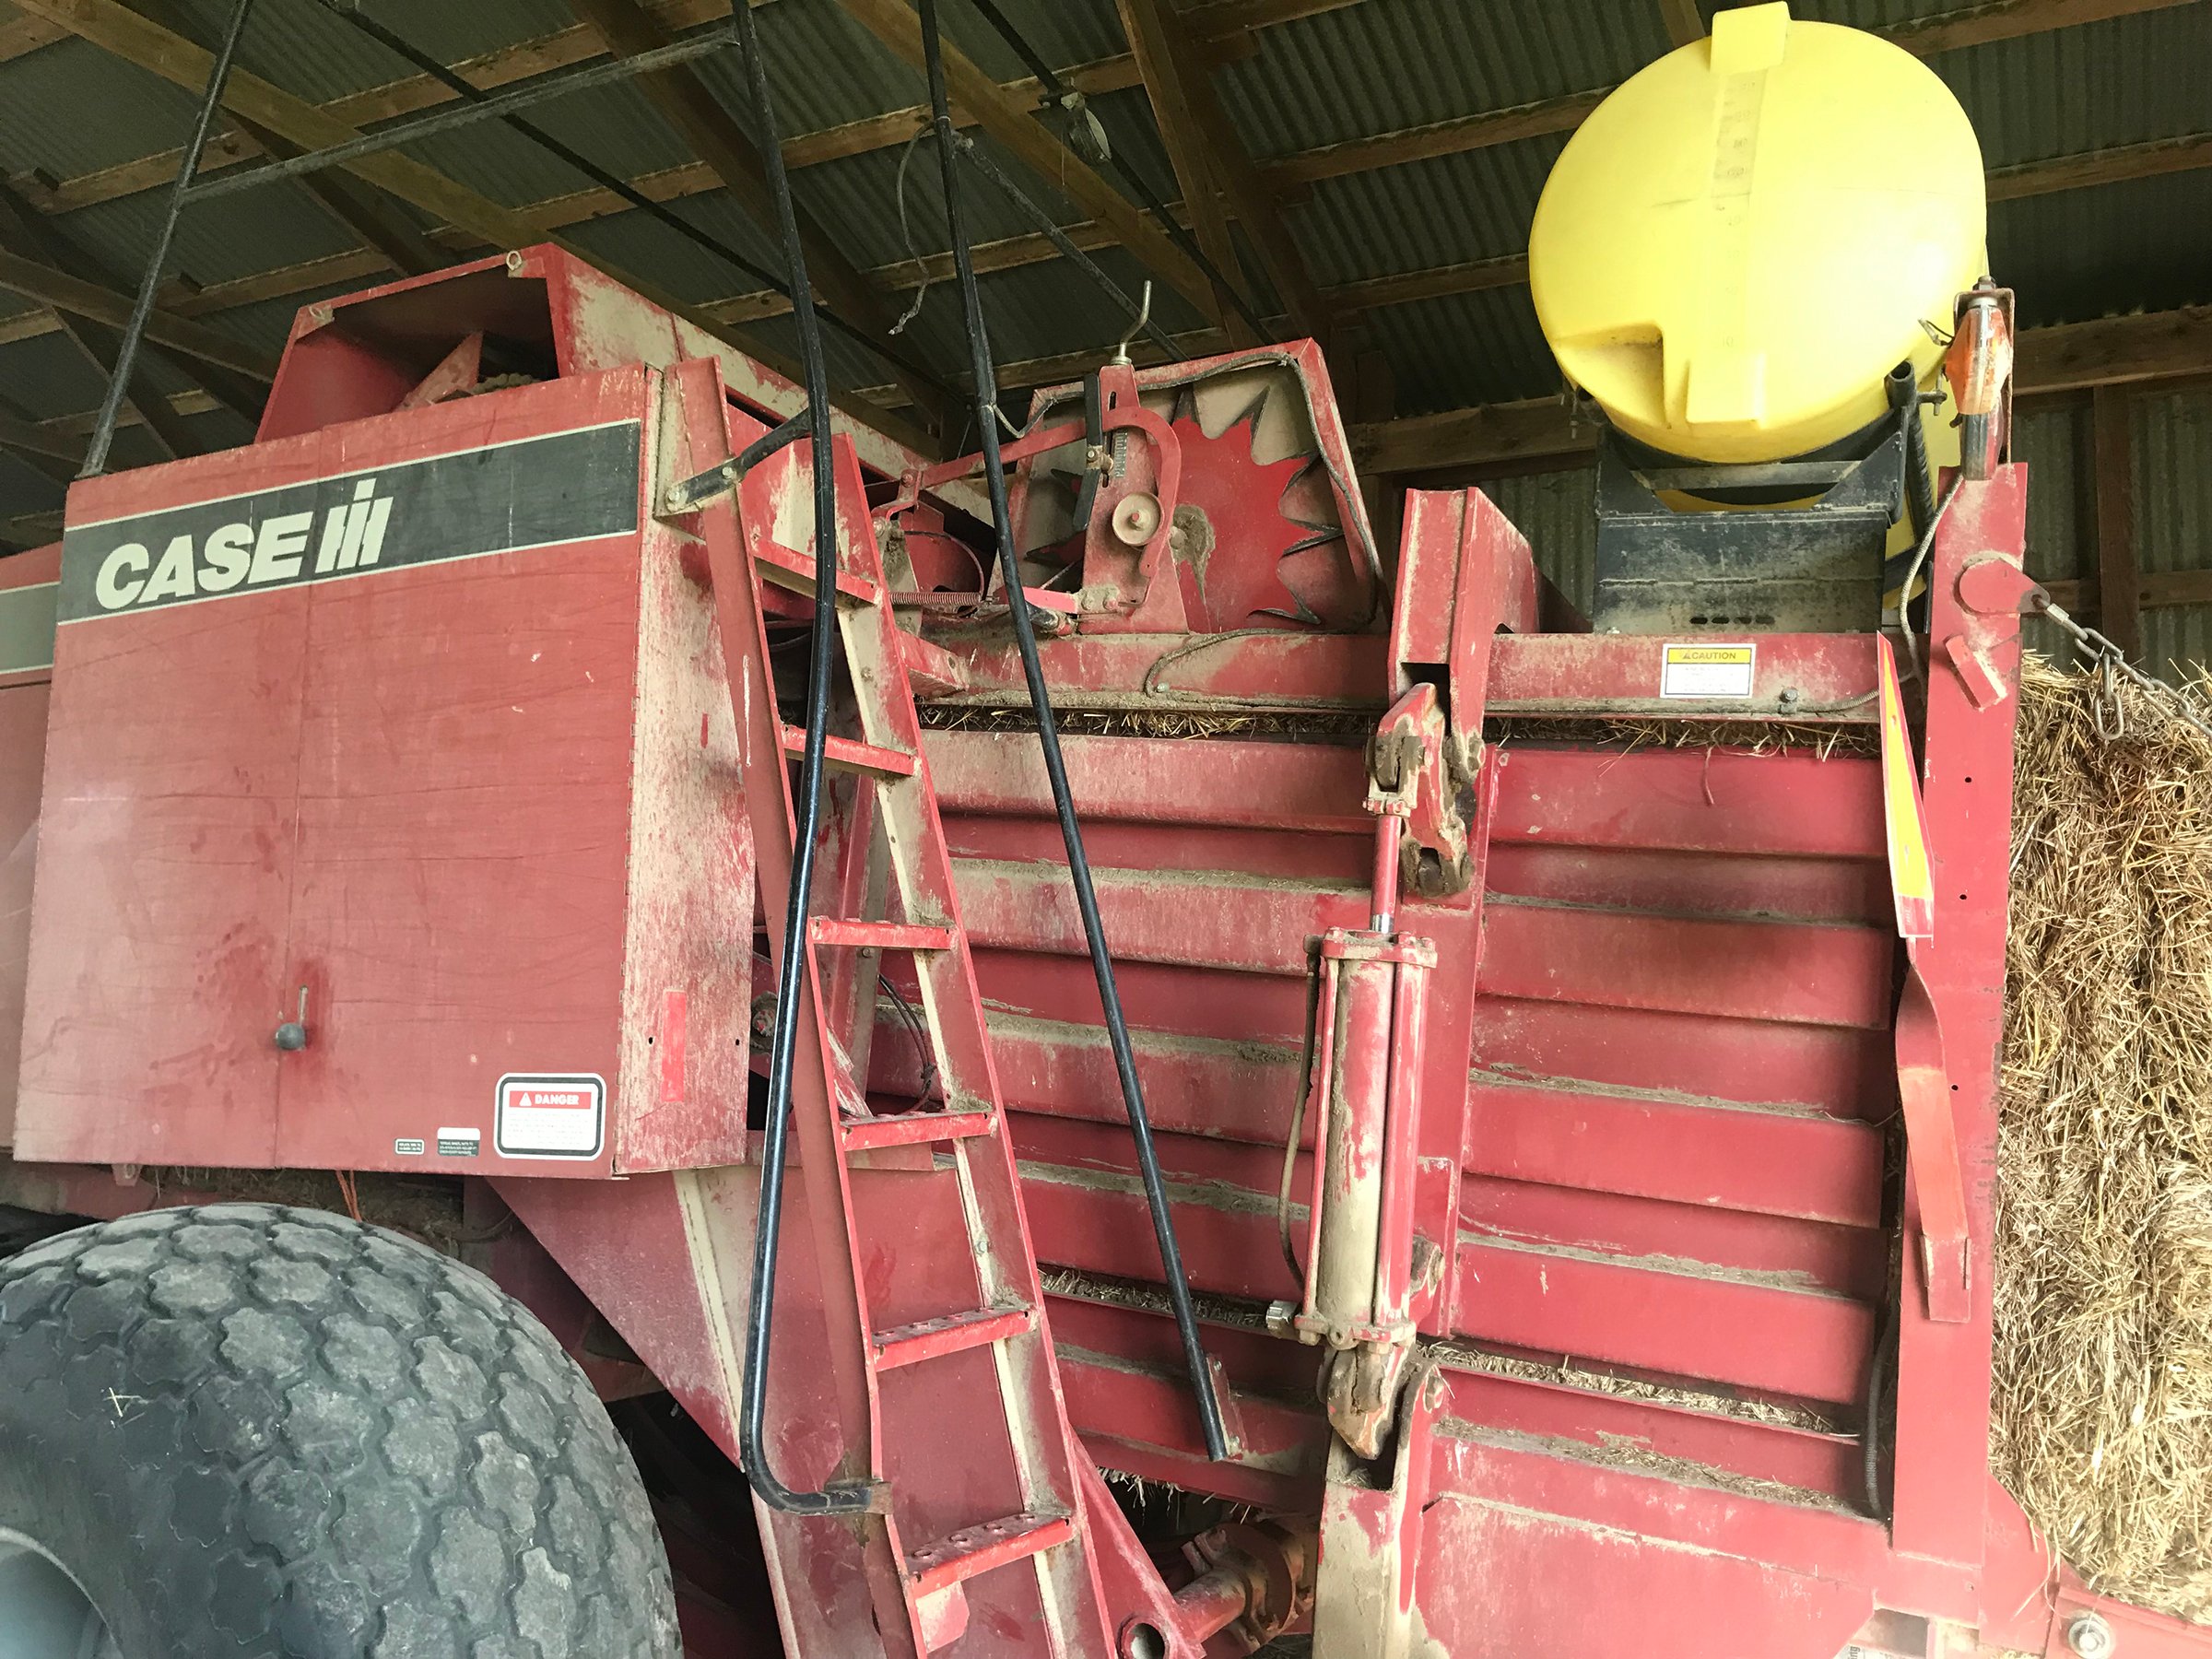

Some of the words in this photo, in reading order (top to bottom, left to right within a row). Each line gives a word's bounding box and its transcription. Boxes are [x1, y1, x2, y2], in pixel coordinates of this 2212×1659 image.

[95, 512, 312, 609] CASE
[1691, 652, 1736, 660] CAUTION
[535, 1094, 579, 1105] DANGER
